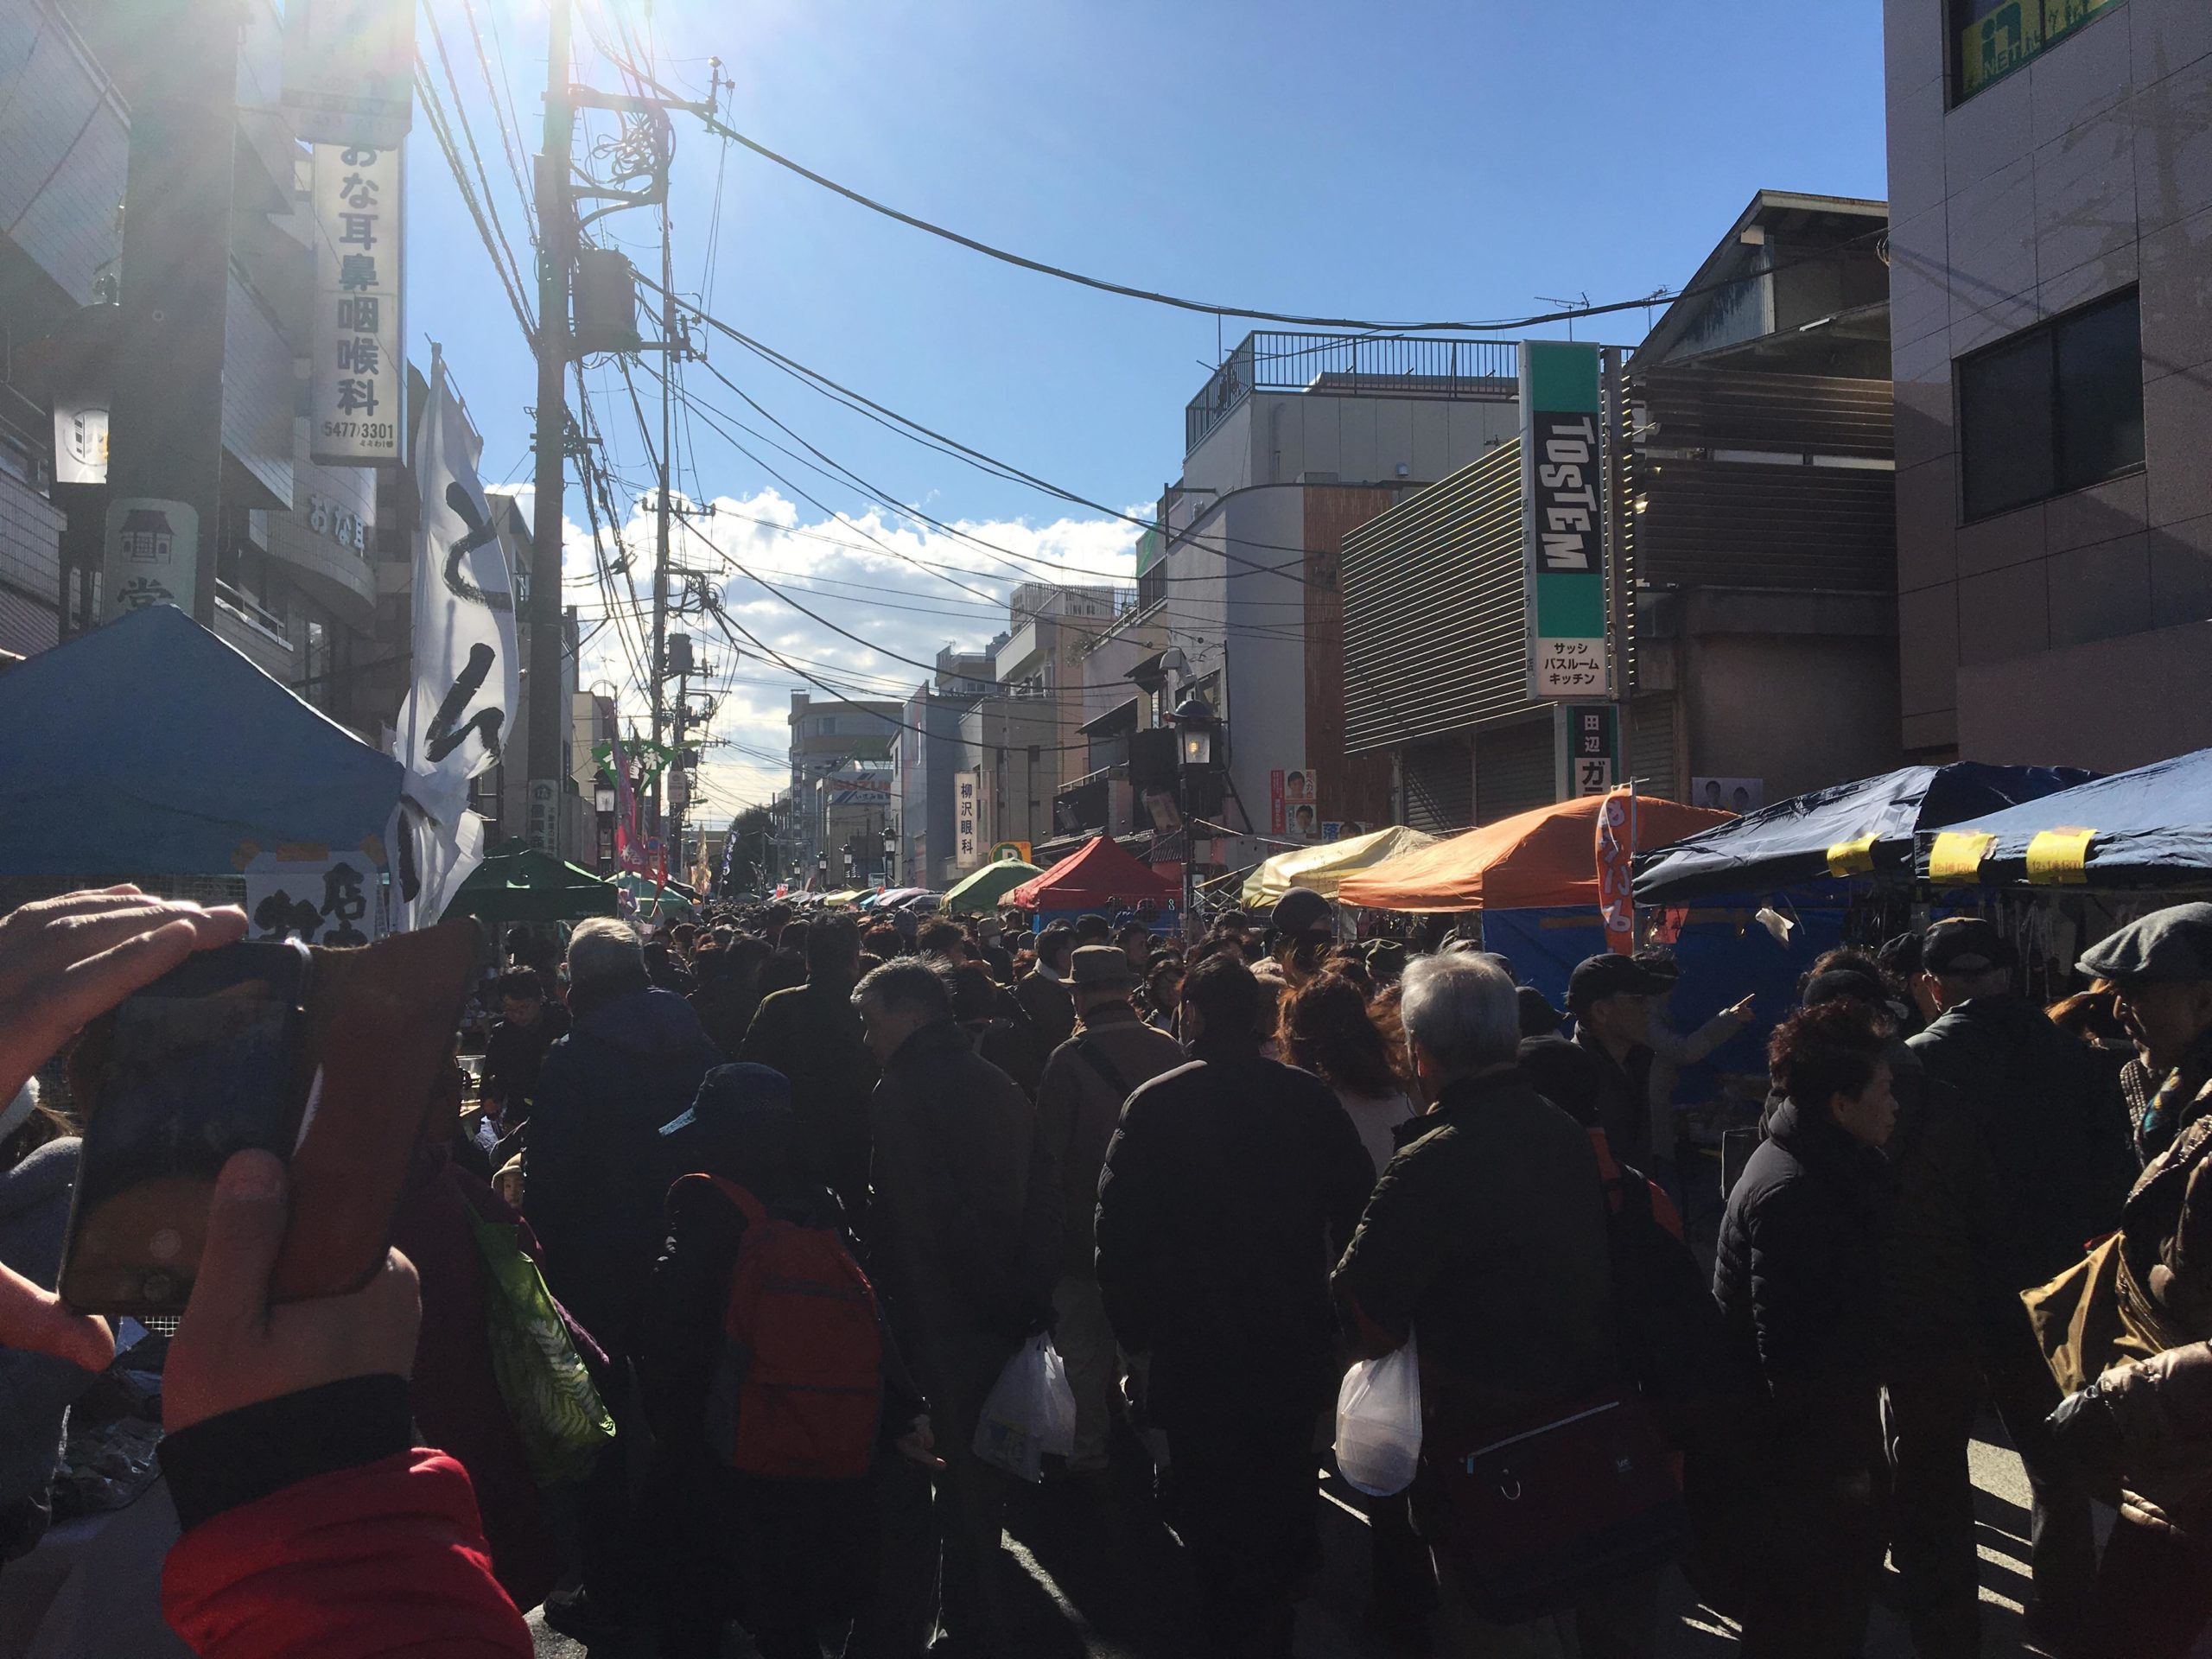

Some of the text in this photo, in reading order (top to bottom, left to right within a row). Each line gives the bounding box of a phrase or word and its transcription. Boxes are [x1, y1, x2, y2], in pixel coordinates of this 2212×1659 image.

[1539, 416, 1598, 569] TOSTEM
[1554, 643, 1588, 654] サッシ
[1545, 658, 1599, 670] バスルーム
[1549, 674, 1595, 685] キッチン
[961, 783, 973, 855] 柳沢眼科
